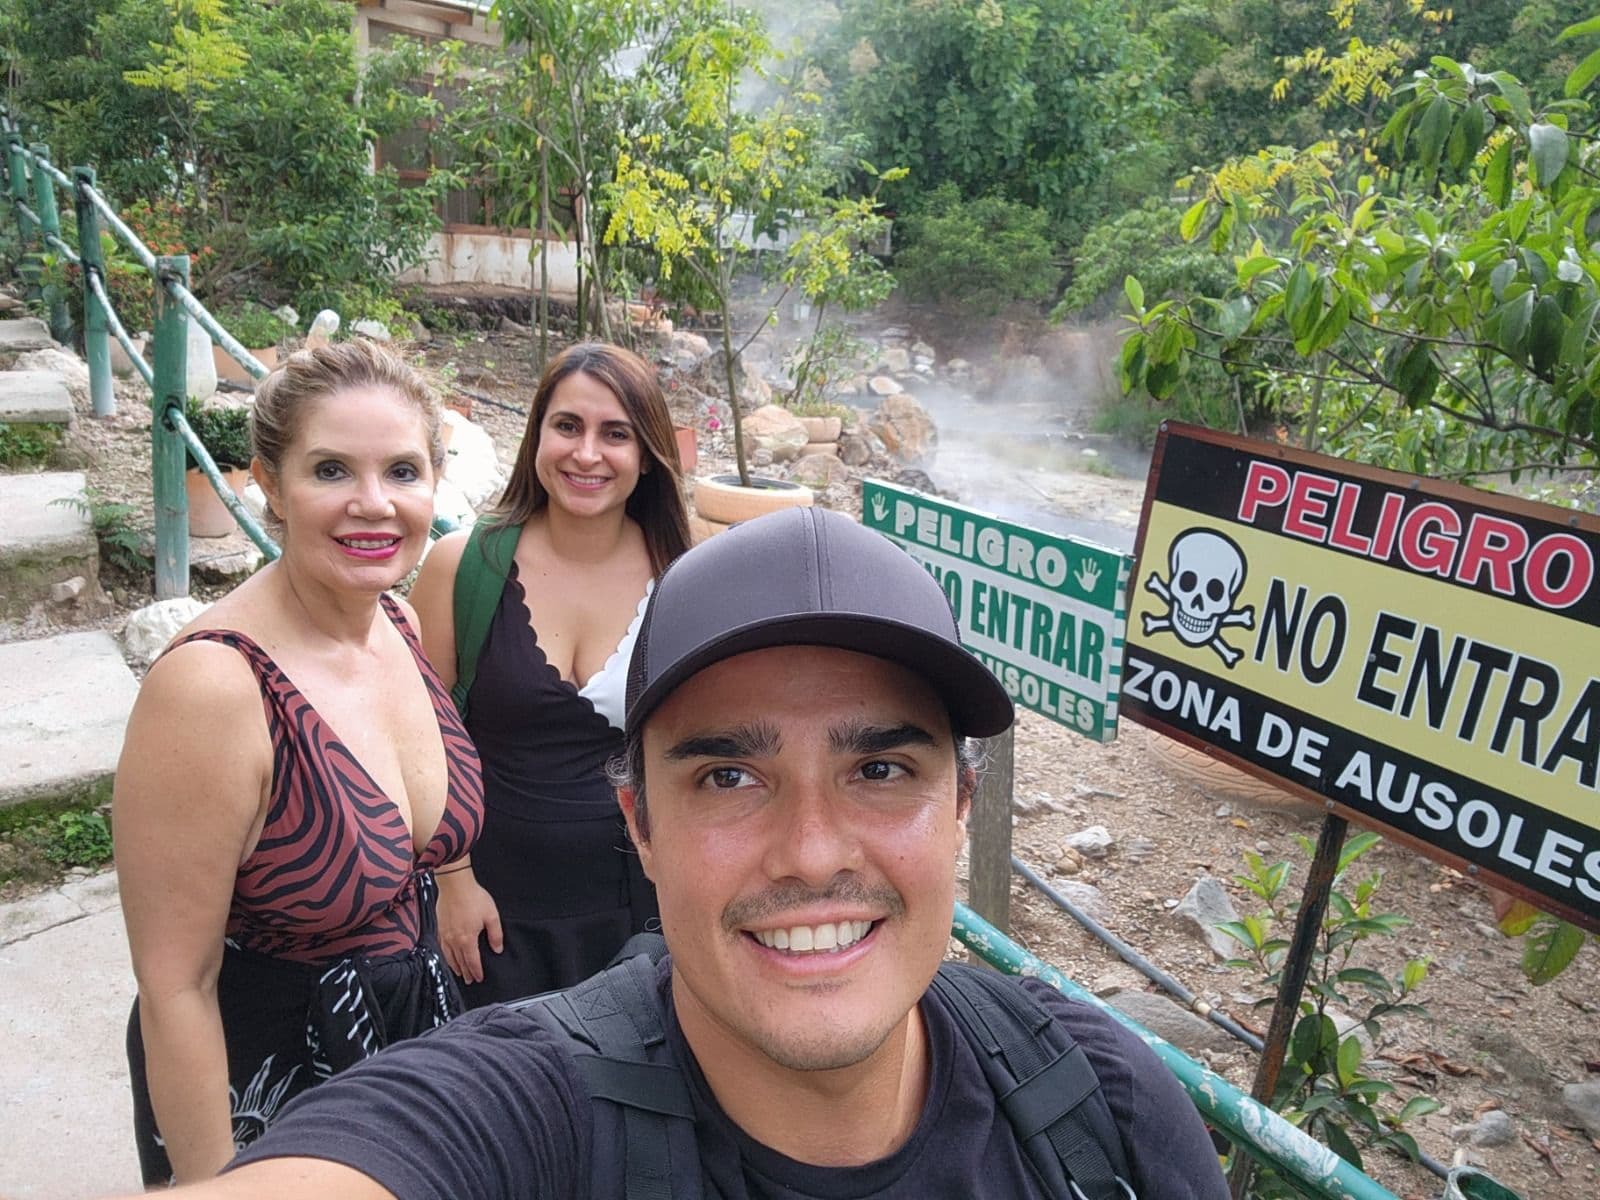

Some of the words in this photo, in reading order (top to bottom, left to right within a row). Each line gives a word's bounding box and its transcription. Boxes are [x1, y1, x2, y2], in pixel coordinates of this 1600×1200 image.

[894, 499, 1068, 587] PELIGRO
[1238, 460, 1594, 609] PELIGRO
[924, 561, 962, 624] O
[970, 579, 1105, 684] ENTRAR
[1253, 576, 1348, 686] NO
[1122, 657, 1242, 742] ZONA
[1256, 715, 1330, 777] DE
